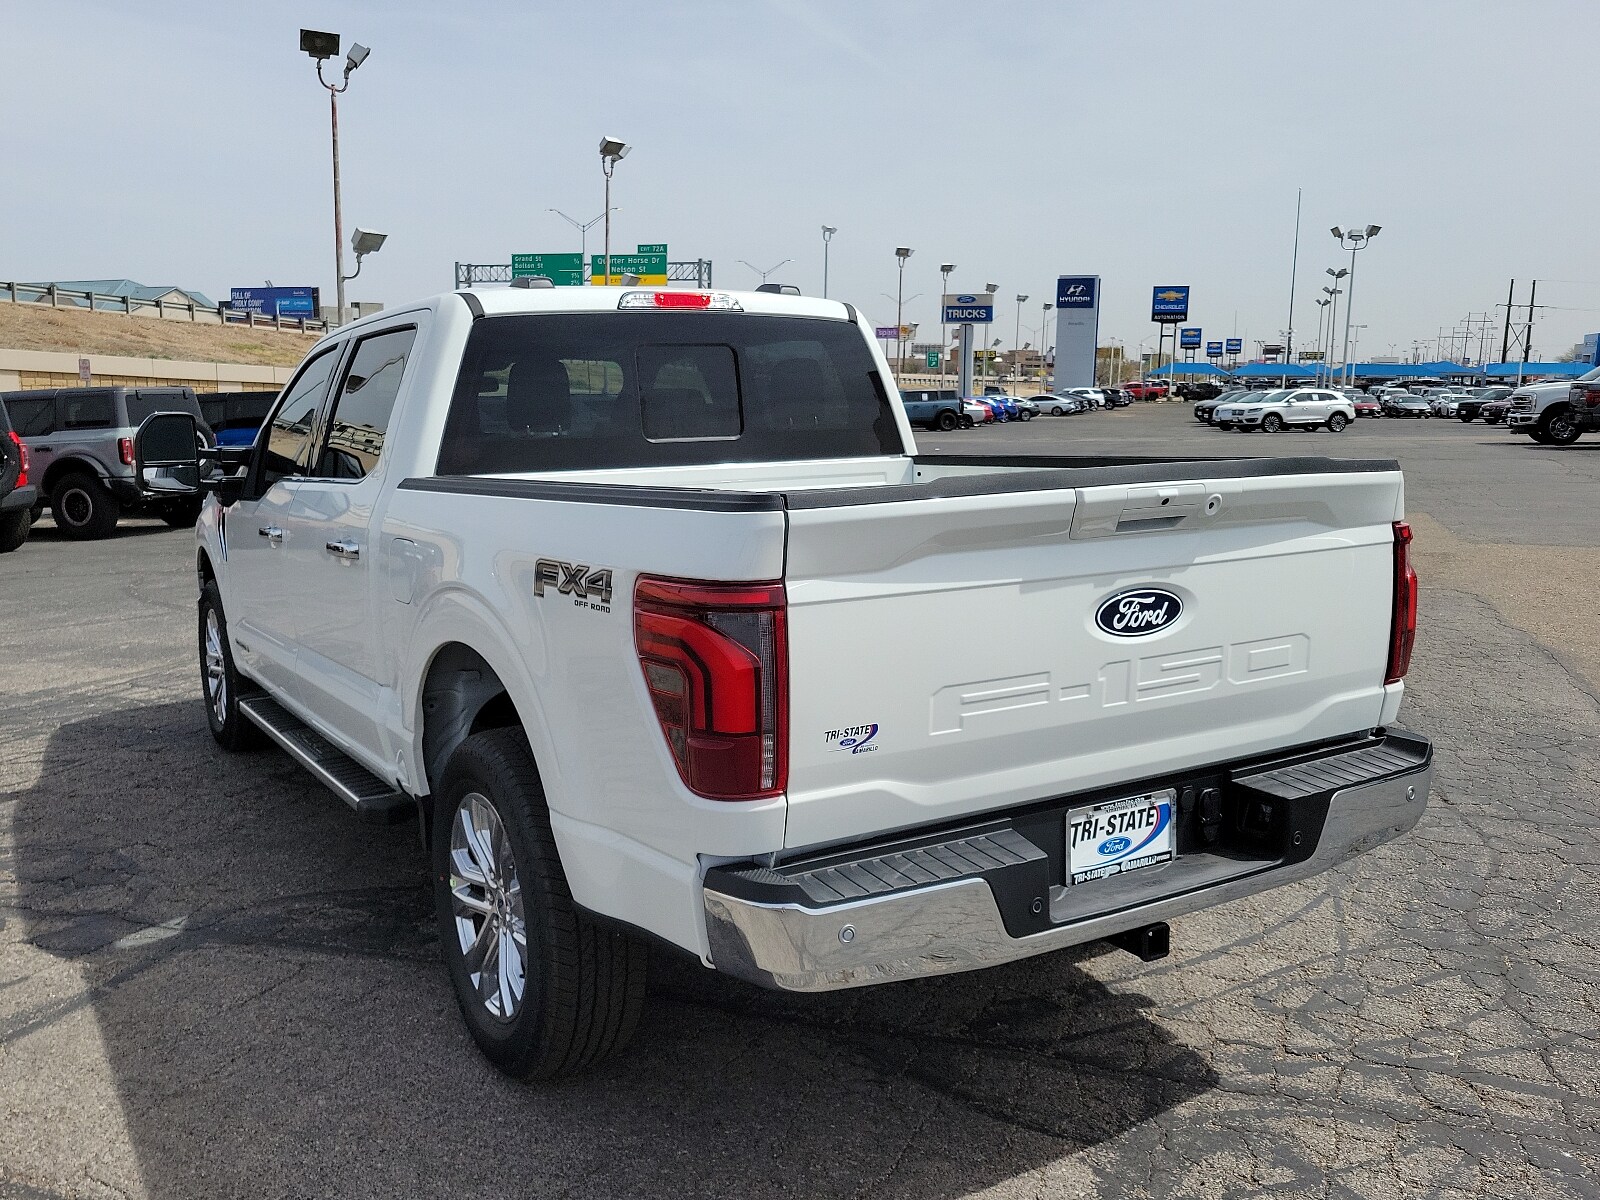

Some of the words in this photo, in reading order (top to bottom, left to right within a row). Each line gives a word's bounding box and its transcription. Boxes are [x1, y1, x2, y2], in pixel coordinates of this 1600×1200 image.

[597, 257, 624, 265] Qurter
[231, 291, 244, 299] FULL
[244, 291, 252, 299] OF
[946, 308, 987, 319] TRUCKS
[534, 557, 613, 605] FX4
[574, 599, 589, 608] OFF
[590, 602, 611, 613] ROAD
[1112, 595, 1169, 631] Ford
[928, 632, 1311, 736] F-150
[824, 724, 872, 743] TRI-STATE
[1070, 806, 1157, 850] TRI-STATE
